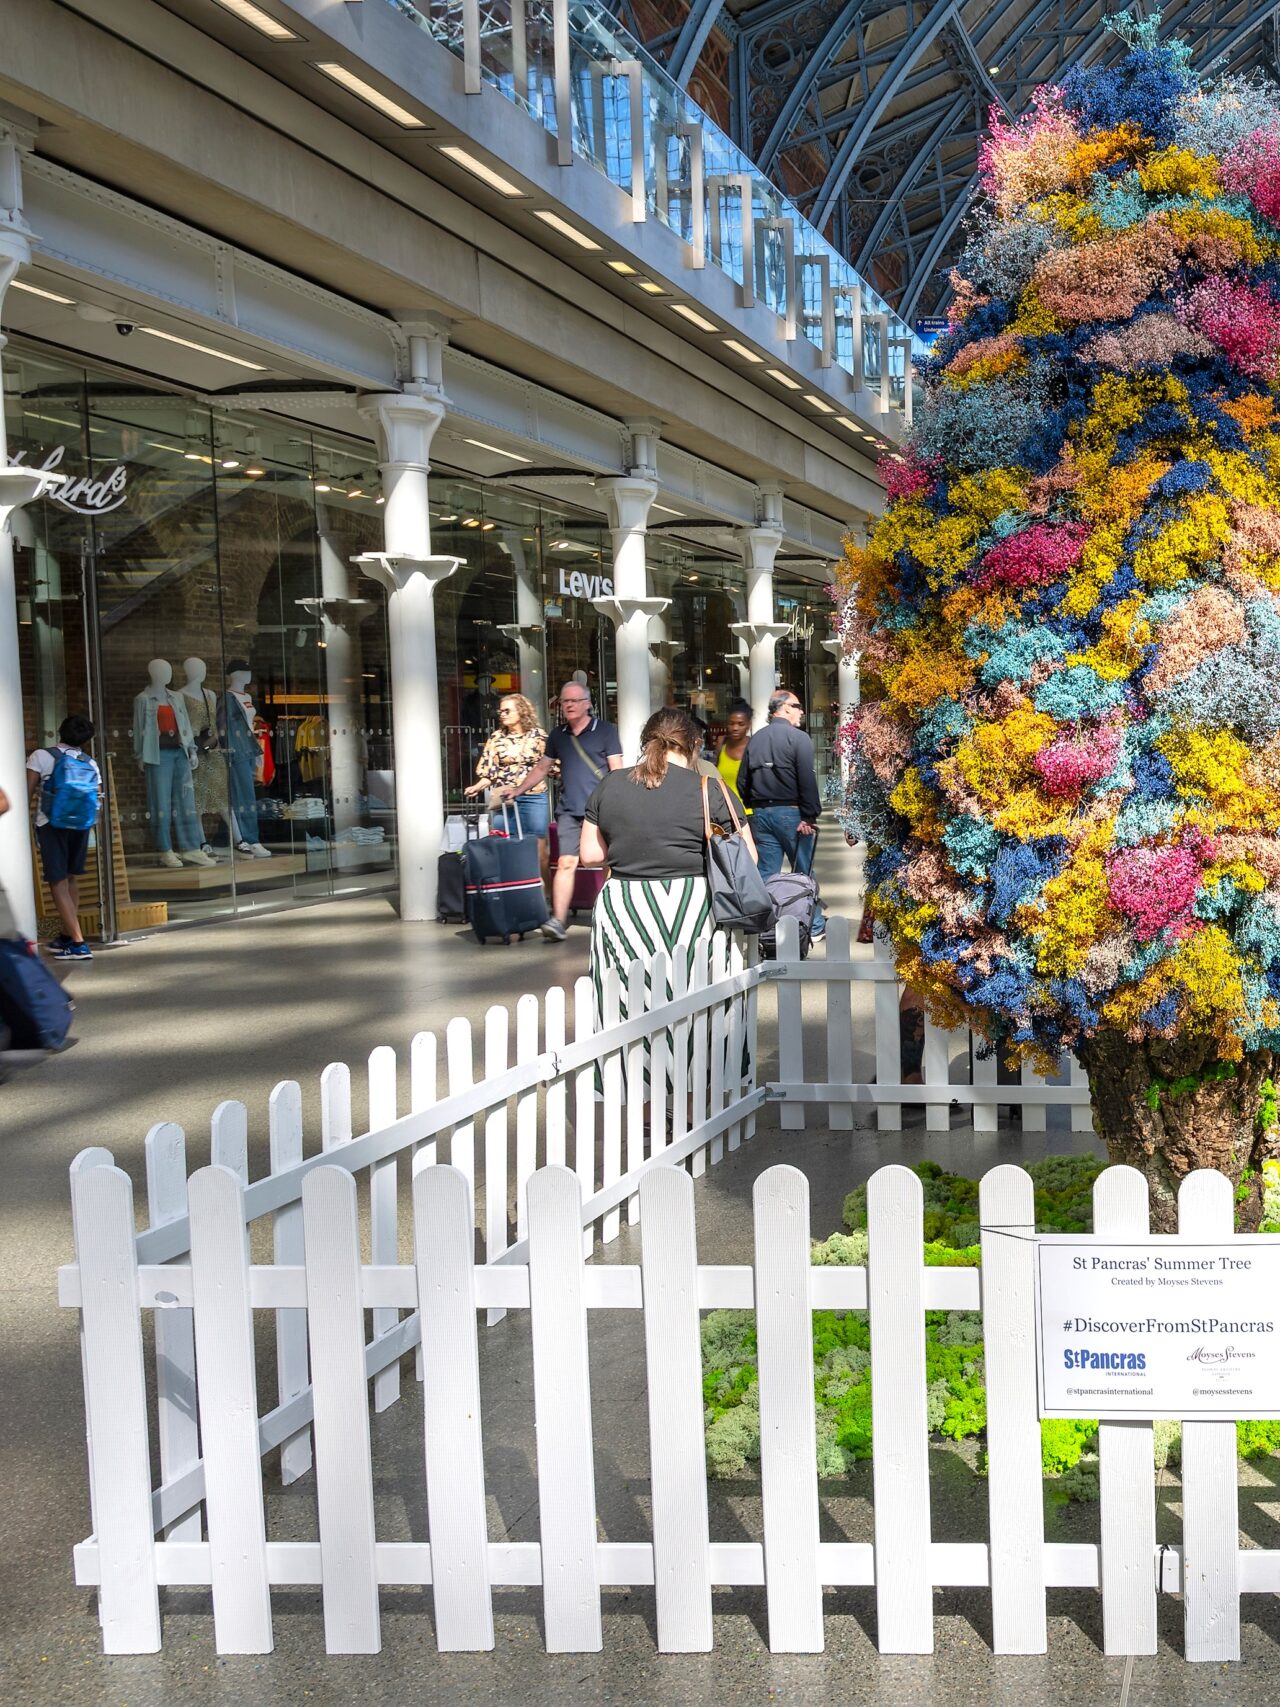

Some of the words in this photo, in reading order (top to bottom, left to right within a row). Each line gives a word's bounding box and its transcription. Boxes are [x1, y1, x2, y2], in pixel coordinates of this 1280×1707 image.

[1073, 1257, 1087, 1269] St
[1091, 1257, 1150, 1270] Pancras'
[1154, 1257, 1215, 1270] Summer
[1219, 1257, 1252, 1269] Tree
[1146, 1277, 1155, 1287] by
[1158, 1278, 1188, 1287] Moyses
[1191, 1278, 1223, 1286] Stevens
[1063, 1318, 1274, 1333] #DiscoverFromStPancras
[1186, 1345, 1223, 1364] Moyses
[1220, 1345, 1256, 1363] Stevens
[1066, 1387, 1154, 1396] @stpancrasinternational
[1192, 1388, 1253, 1396] @moysesstevens
